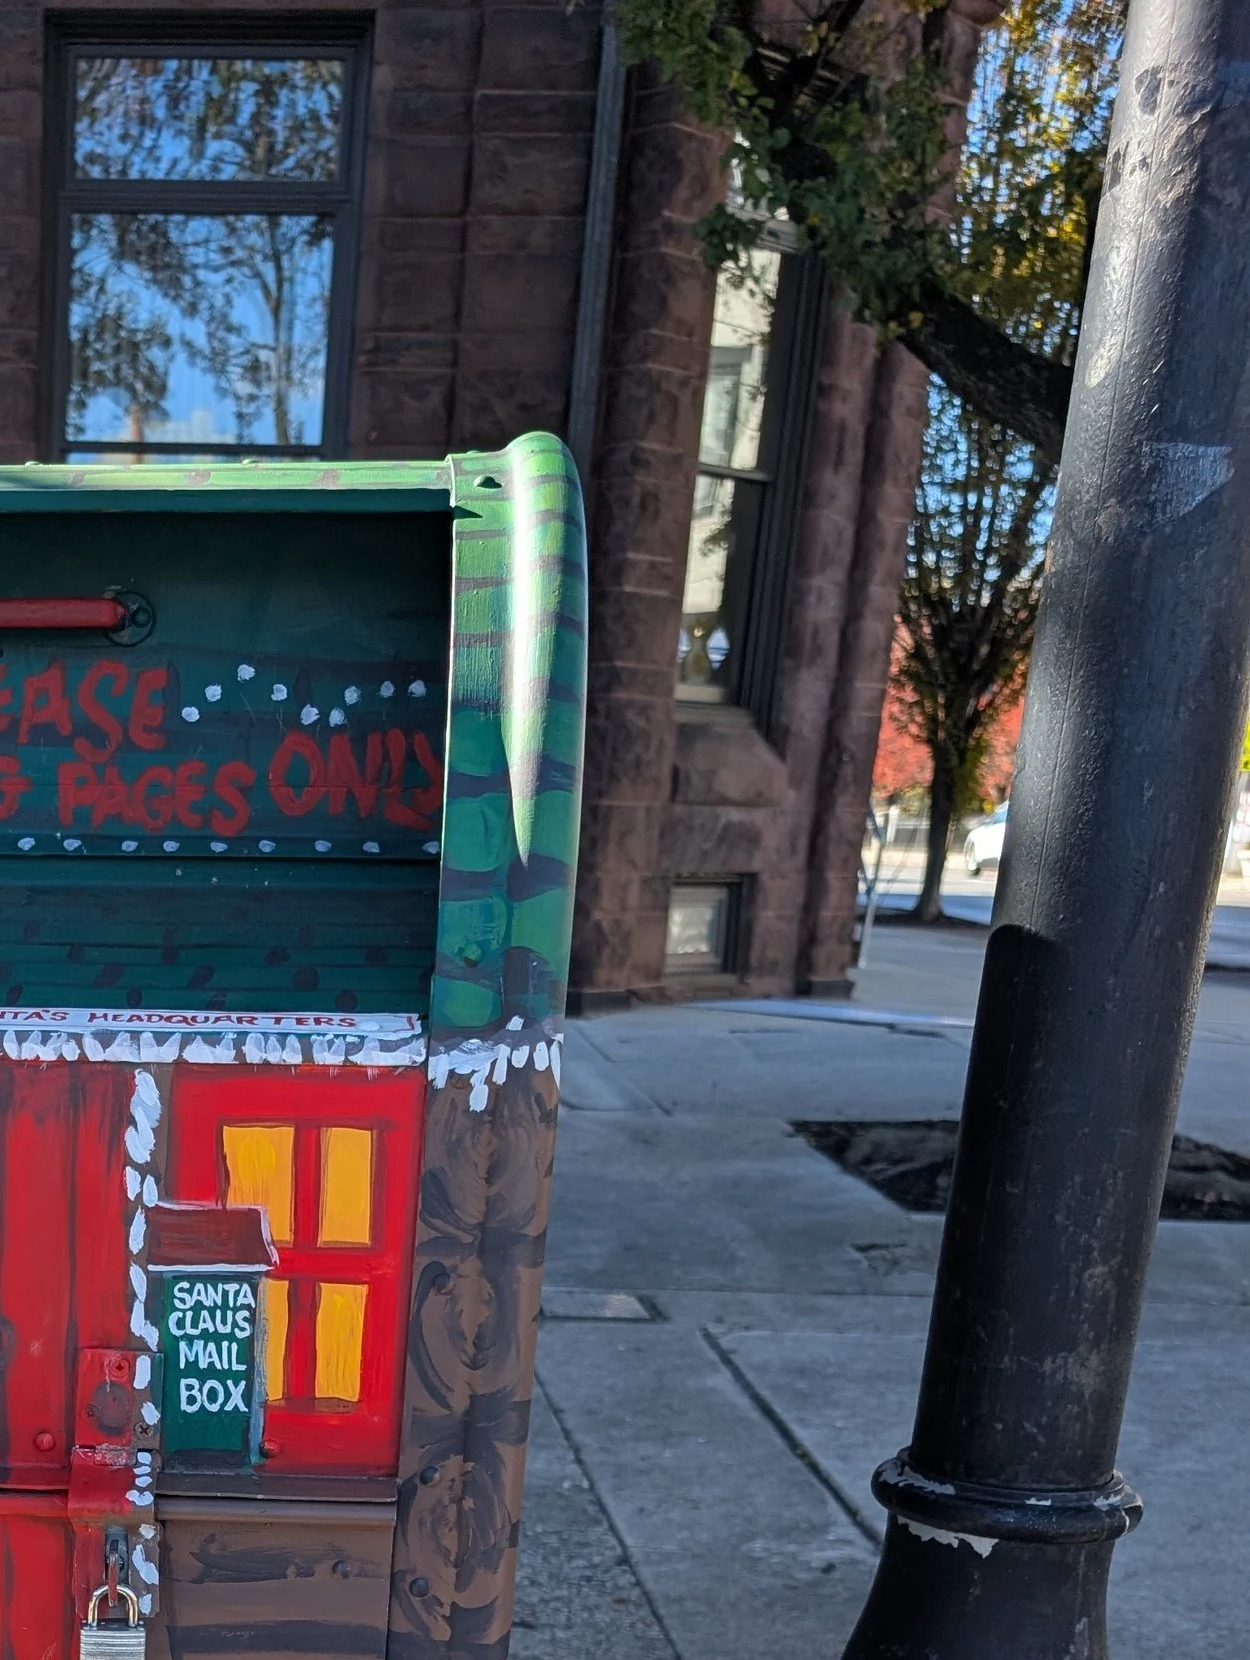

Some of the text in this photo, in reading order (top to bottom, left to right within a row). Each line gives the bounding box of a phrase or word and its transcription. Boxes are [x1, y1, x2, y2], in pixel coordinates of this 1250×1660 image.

[57, 760, 257, 837] PAGES
[172, 1281, 257, 1310] SANTA
[168, 1309, 254, 1340] CLAUS
[178, 1339, 248, 1371] MAIL
[180, 1377, 249, 1414] BOX
